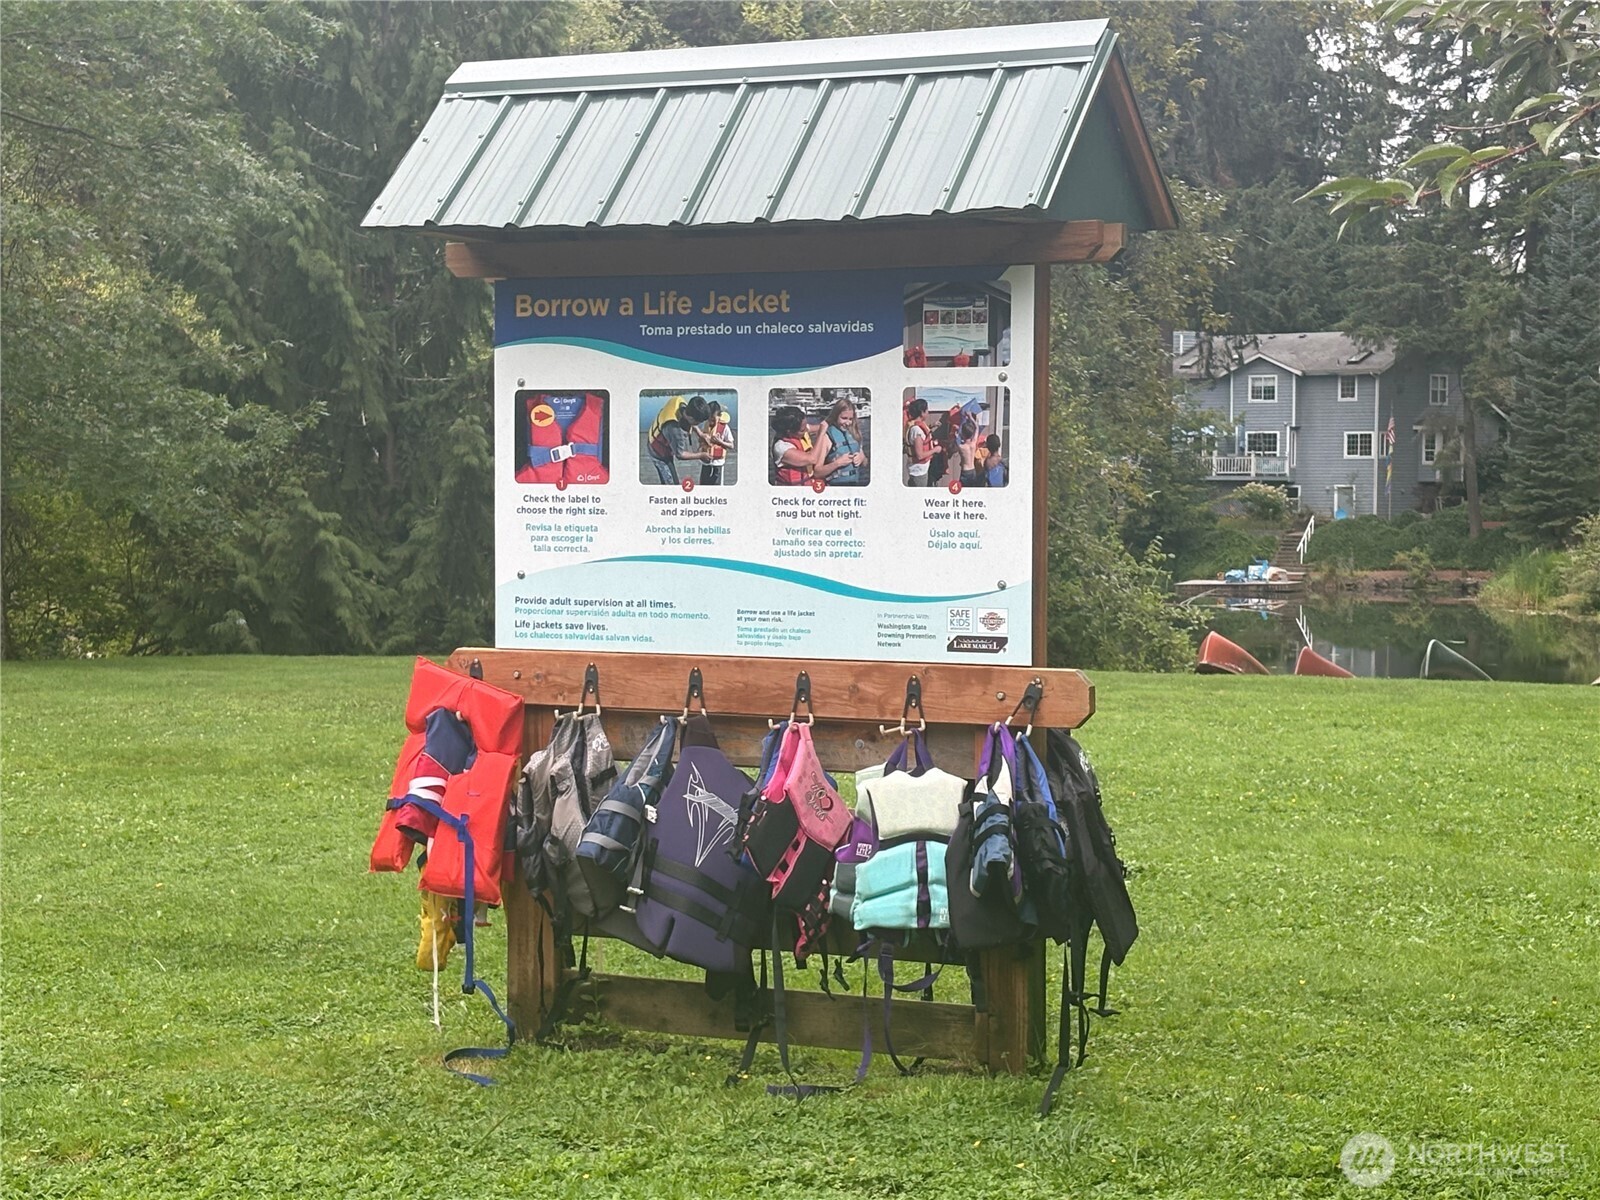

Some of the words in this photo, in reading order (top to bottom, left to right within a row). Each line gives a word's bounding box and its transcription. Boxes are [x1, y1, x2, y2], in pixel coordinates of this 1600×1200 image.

[515, 294, 610, 318] Borrow
[618, 300, 633, 316] a
[643, 291, 692, 315] Life
[701, 289, 791, 315] Jacket
[639, 324, 673, 336] Toma
[677, 323, 732, 337] prestado
[736, 325, 752, 334] un
[755, 322, 804, 334] chaleco
[808, 320, 874, 333] salvavidas
[684, 480, 690, 489] 2
[816, 481, 822, 490] 3
[951, 482, 958, 491] 4
[522, 494, 549, 503] Check
[551, 495, 566, 503] the
[568, 495, 589, 503] label
[592, 496, 601, 504] to
[649, 496, 678, 505] Fasten
[680, 496, 691, 505] all
[693, 496, 728, 505] buckles
[771, 497, 800, 506] Check
[802, 497, 815, 506] for
[818, 498, 851, 507] correct
[854, 498, 867, 507] fit:
[924, 498, 950, 508] Wear
[952, 498, 959, 508] it
[962, 499, 987, 508] here.
[516, 506, 547, 514] choose
[549, 506, 563, 514] the
[565, 506, 586, 516] right
[588, 507, 608, 515] size.
[660, 508, 678, 516] and
[680, 508, 715, 518] zippers.
[776, 510, 798, 519] snug
[800, 509, 816, 518] but
[819, 510, 834, 518] not
[837, 510, 862, 520] tight.
[923, 511, 951, 520] Leave
[953, 510, 960, 520] it
[963, 511, 988, 520] here.
[525, 523, 552, 531] Revisa
[564, 524, 598, 533] etiqueta
[645, 525, 681, 533] Abrocha
[683, 525, 695, 534] las
[698, 525, 731, 534] hebillas
[785, 527, 822, 536] Verificar
[824, 529, 842, 537] que
[844, 528, 853, 536] el
[929, 527, 955, 538] Úsalo
[957, 529, 981, 539] aquí.
[530, 535, 549, 543] para
[661, 537, 667, 545] y
[668, 536, 681, 544] los
[683, 536, 715, 545] cierres.
[772, 538, 805, 546] tamaño
[825, 539, 865, 547] correcto:
[533, 544, 551, 552] talla
[553, 545, 591, 553] correcta.
[927, 540, 957, 550] Déjalo
[959, 541, 983, 551] aquí.
[773, 548, 811, 558] ajustado
[814, 549, 827, 557] sin
[829, 550, 864, 559] apretar.
[514, 596, 547, 605] Provide
[549, 597, 571, 606] adult
[573, 598, 623, 607] supervision
[636, 599, 647, 608] all
[649, 600, 677, 609] times.
[514, 606, 564, 615] Proporcionar
[566, 607, 609, 617] supervisión
[611, 609, 636, 617] adulta
[650, 610, 668, 619] todo
[670, 612, 711, 620] momento.
[949, 609, 971, 618] SAFE
[514, 619, 531, 628] Life
[532, 620, 563, 630] jackets
[586, 622, 609, 631] lives.
[877, 623, 911, 631] Washington
[514, 630, 528, 638] Los
[530, 631, 563, 640] chalecos
[565, 632, 604, 641] salvavidas
[605, 633, 630, 641] salvan
[632, 634, 655, 643] vidas.
[877, 631, 905, 640] Drowning
[905, 632, 937, 640] Prevention
